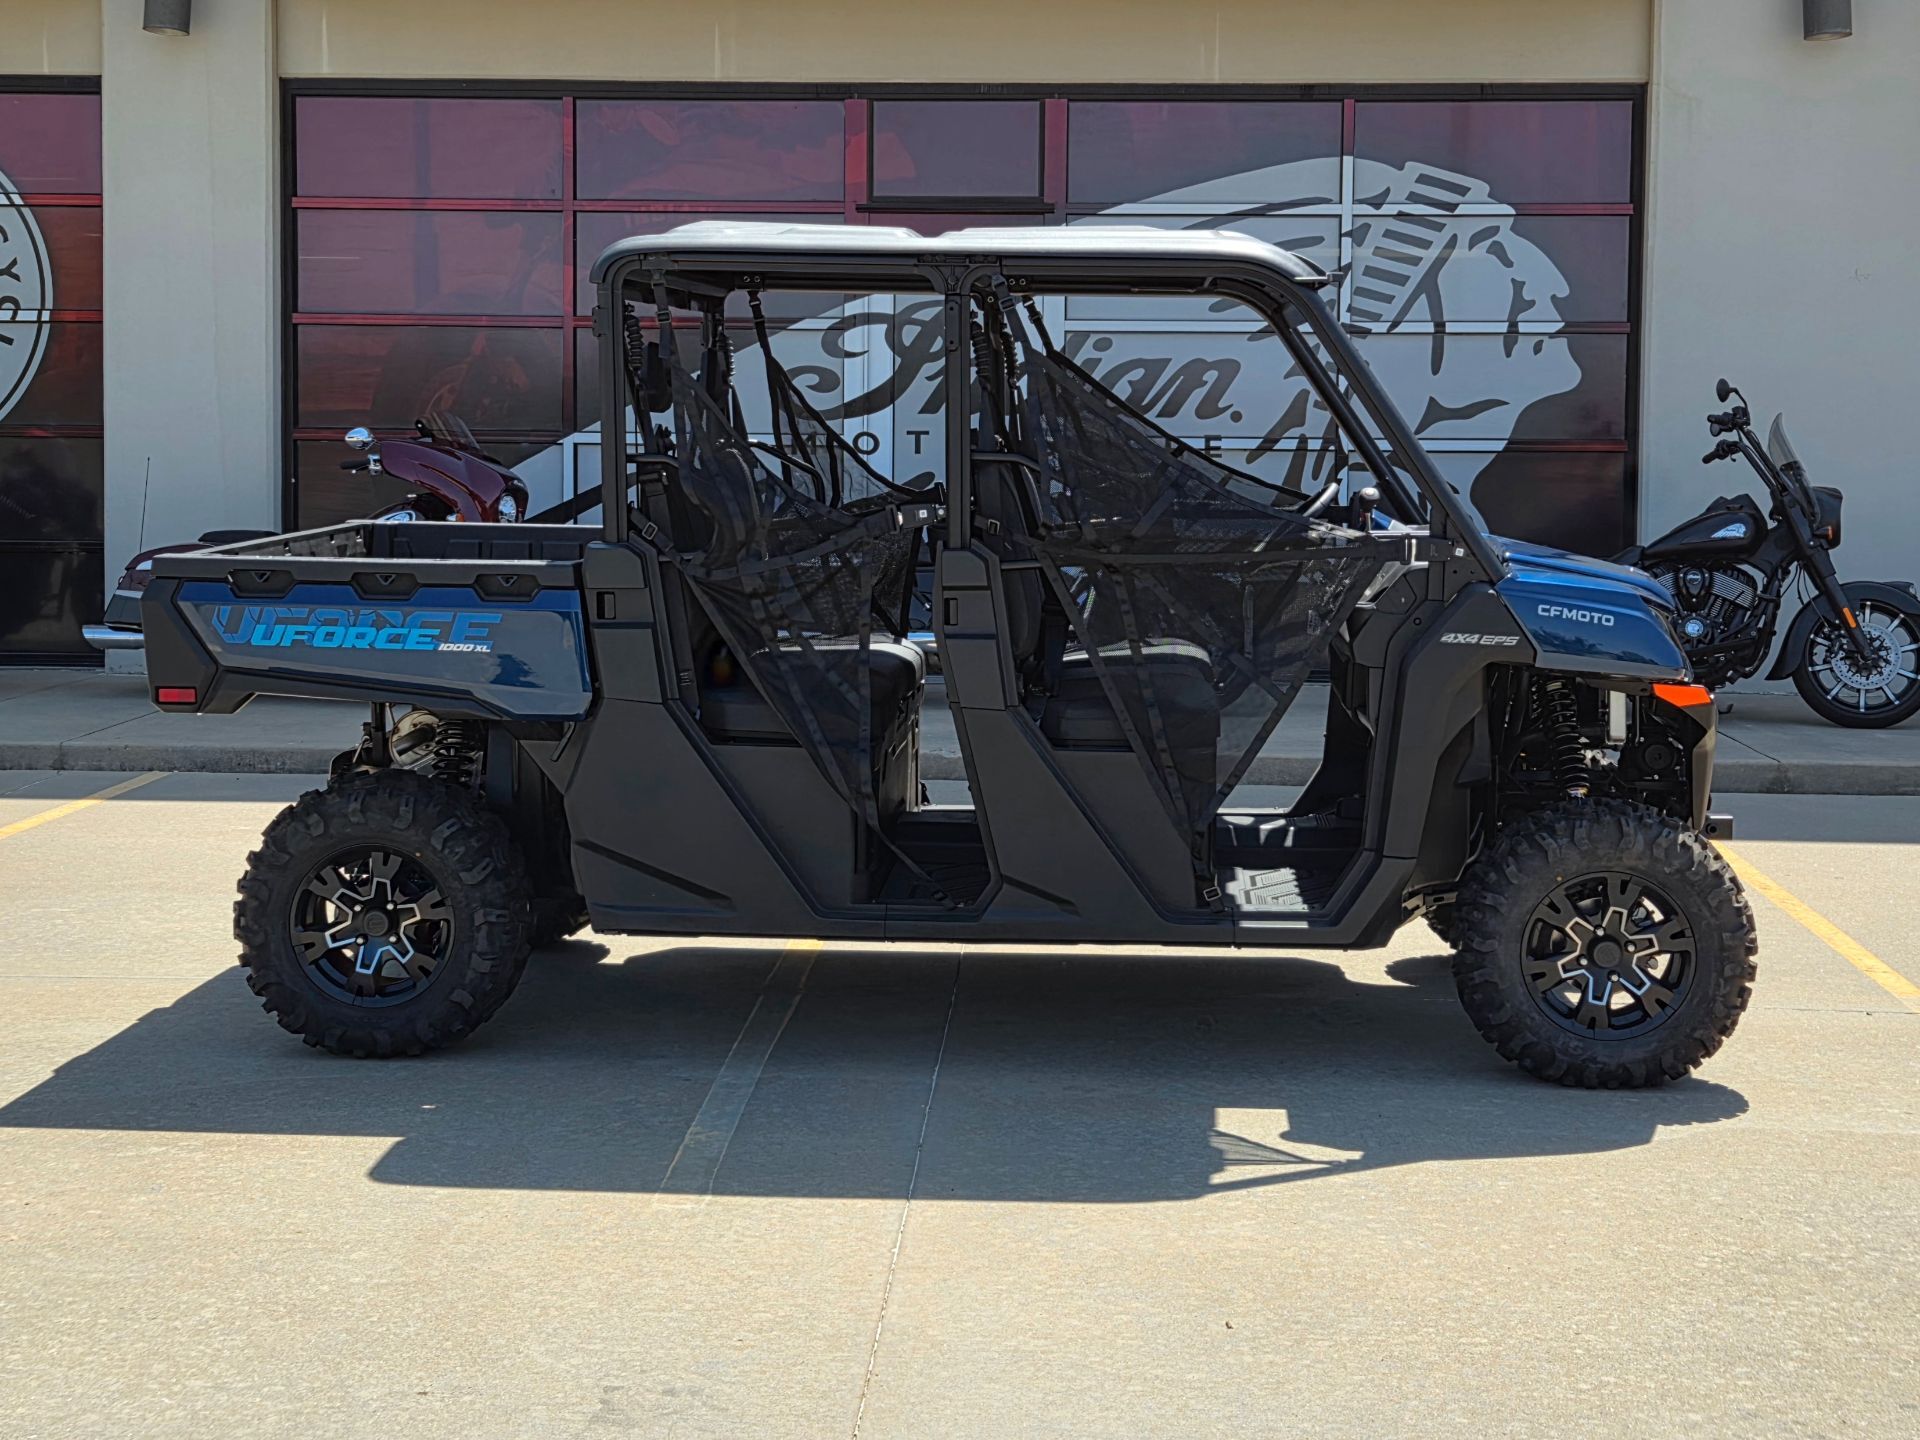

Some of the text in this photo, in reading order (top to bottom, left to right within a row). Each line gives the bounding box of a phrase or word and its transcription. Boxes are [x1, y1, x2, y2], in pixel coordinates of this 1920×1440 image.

[1537, 604, 1615, 626] CFMOTO
[250, 624, 441, 650] UFORCE
[1479, 635, 1520, 646] EPS
